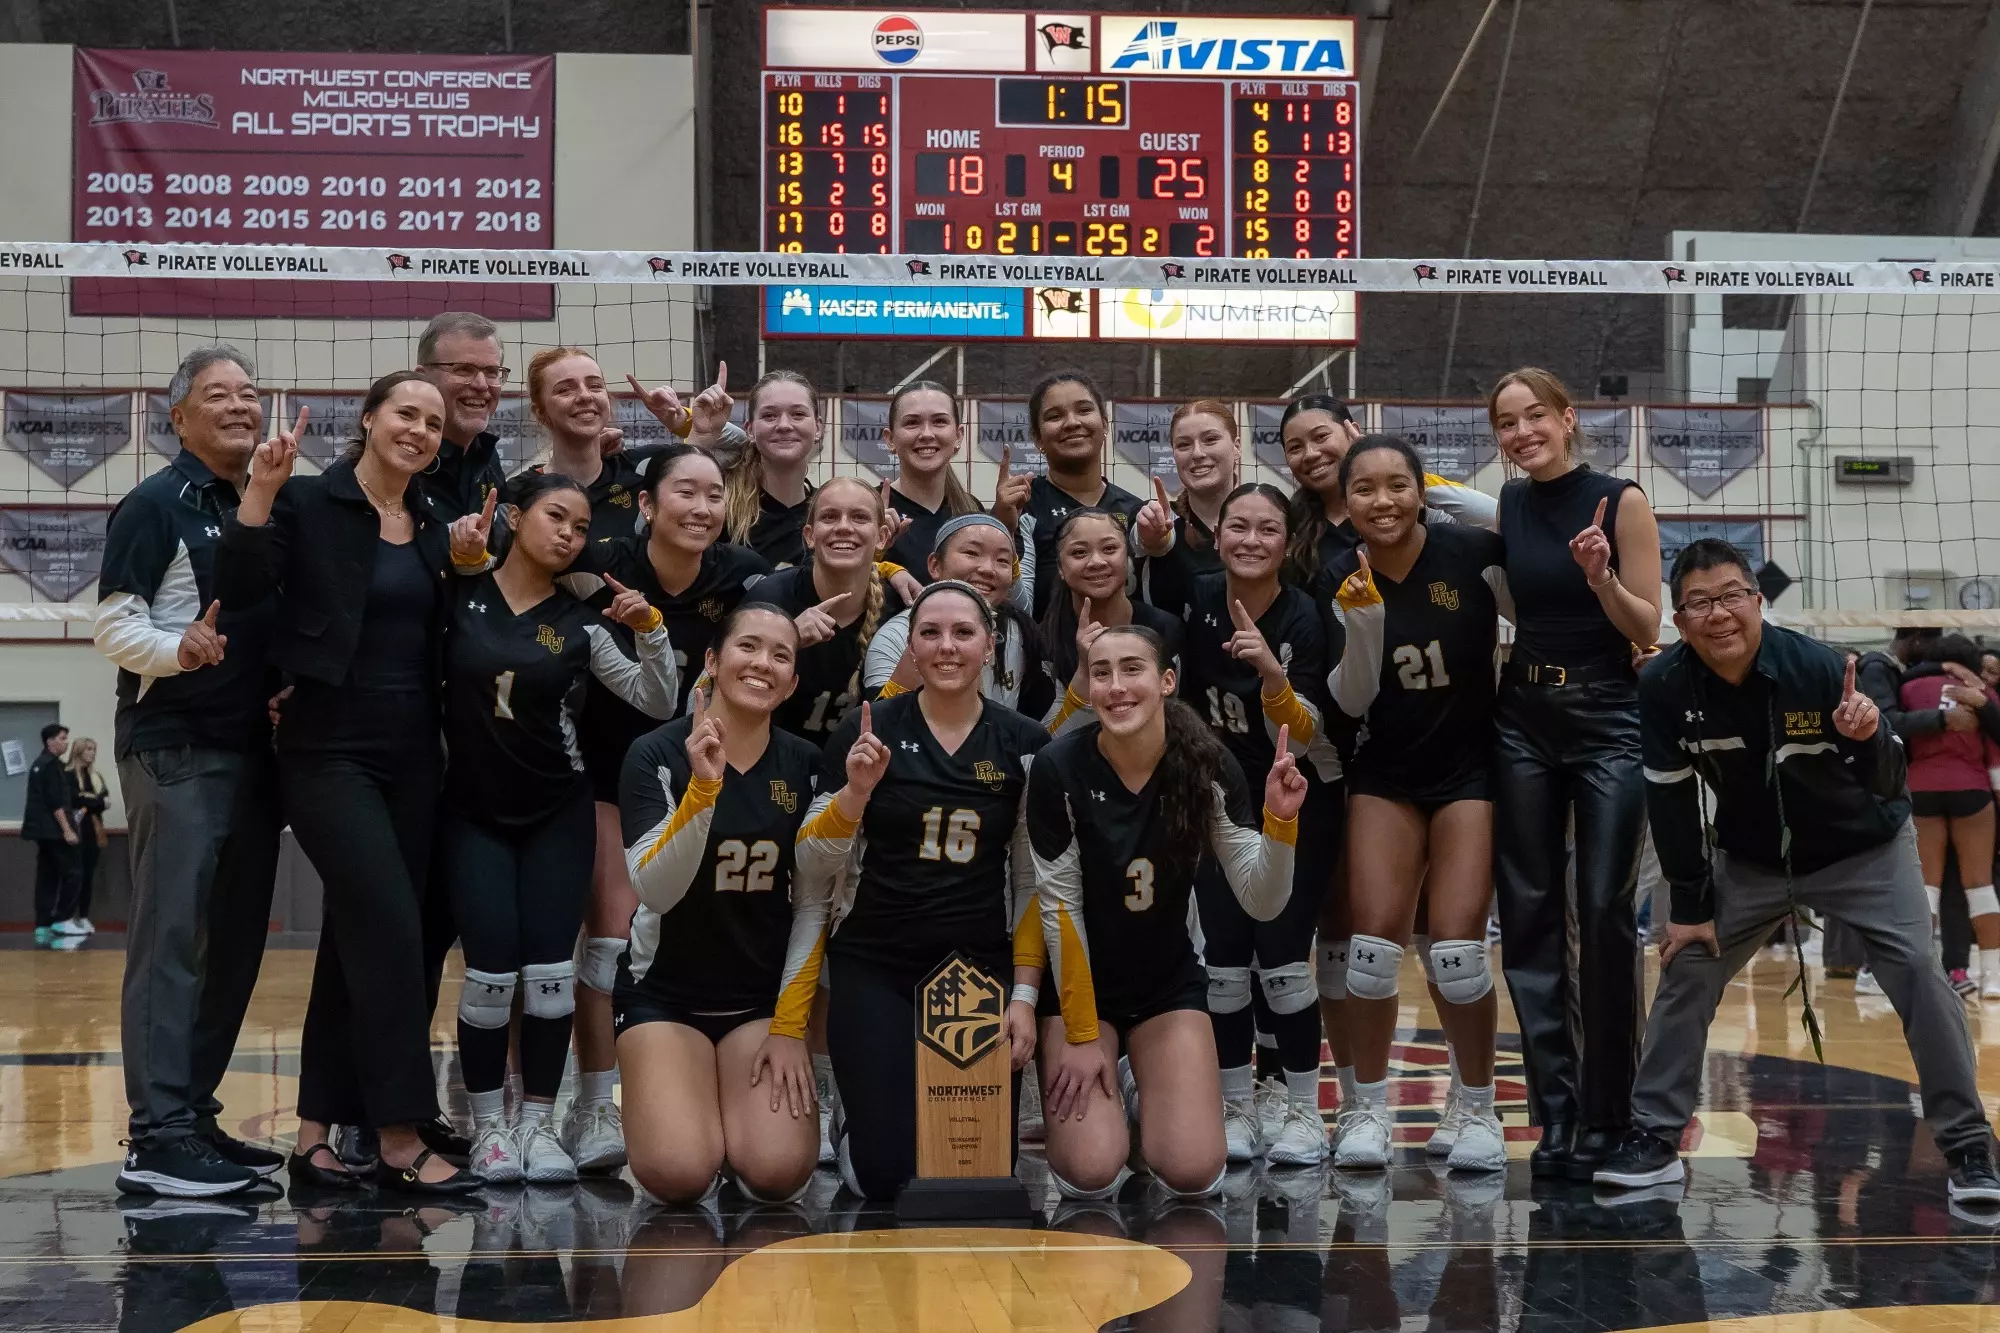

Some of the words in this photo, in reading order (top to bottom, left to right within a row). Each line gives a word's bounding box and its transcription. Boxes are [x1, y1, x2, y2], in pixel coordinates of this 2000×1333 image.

[876, 35, 920, 46] PEPSI
[1110, 21, 1346, 71] AVISTA
[241, 68, 379, 87] NORTHWEST
[384, 71, 532, 89] CONFERENCE
[774, 75, 801, 88] PLYR
[814, 75, 842, 89] KILLS
[857, 76, 882, 89] DIGS
[1240, 82, 1266, 95] PLYR
[1281, 83, 1309, 96] KILLS
[1323, 84, 1346, 97] DIGS
[89, 89, 215, 122] PIRATES
[303, 90, 470, 109] MCILROY-LEWIS
[779, 92, 803, 116] 10
[1048, 84, 1122, 123] 1:15
[1253, 102, 1269, 122] 4
[1286, 102, 1310, 122] 11
[1335, 101, 1351, 125] 8
[232, 112, 284, 136] ALL
[291, 112, 411, 137] SPORTS
[418, 115, 540, 139] TROPHY
[779, 121, 803, 146] 16
[821, 123, 845, 147] 15
[863, 123, 887, 147] 15
[926, 129, 980, 148] HOME
[1139, 132, 1201, 152] GUEST
[1253, 130, 1269, 153] 6
[1327, 131, 1351, 154] 13
[779, 151, 803, 176] 13
[832, 153, 845, 174] 7
[871, 153, 887, 176] 0
[1039, 145, 1085, 158] PERIOD
[949, 155, 984, 195] 18
[1053, 162, 1073, 191] 4
[1153, 159, 1205, 198] 25
[1253, 159, 1269, 183] 8
[1296, 160, 1310, 183] 2
[86, 173, 154, 194] 2005
[165, 174, 232, 195] 2008
[243, 175, 310, 196] 2009
[321, 176, 387, 197] 2010
[398, 177, 462, 198] 2011
[475, 178, 541, 199] 2012
[779, 181, 803, 206] 15
[830, 183, 845, 206] 2
[871, 183, 887, 206] 5
[916, 203, 945, 216] WON
[995, 203, 1018, 216] LST
[1021, 203, 1042, 217] GM
[1083, 204, 1107, 217] LST
[1109, 204, 1130, 218] GM
[1246, 188, 1270, 213] 12
[1295, 189, 1311, 213] 0
[1336, 190, 1351, 213] 0
[86, 206, 153, 227] 2013
[165, 207, 232, 228] 2014
[243, 208, 309, 229] 2015
[320, 209, 387, 230] 2016
[398, 210, 464, 231] 2017
[475, 211, 541, 232] 2018
[779, 211, 803, 234] 17
[829, 212, 845, 236] 0
[871, 212, 887, 236] 8
[1179, 207, 1209, 220] WON
[966, 225, 982, 249] 0
[997, 222, 1040, 254] 21
[1085, 223, 1129, 255] 25
[1143, 228, 1158, 252] 2
[1195, 225, 1215, 256] 2
[1246, 217, 1270, 242] 15
[1295, 219, 1311, 242] 8
[1336, 219, 1352, 243] 2
[1, 253, 64, 268] EYBALL
[158, 255, 216, 270] PIRATE
[222, 256, 328, 272] VOLLEYBALL
[421, 259, 479, 274] PIRATE
[486, 260, 590, 277] VOLLEYBALL
[682, 262, 740, 277] PIRATE
[746, 262, 849, 278] VOLLEYBALL
[940, 265, 997, 279] PIRATE
[1002, 266, 1105, 282] VOLLEYBALL
[1194, 268, 1250, 283] PIRATE
[1256, 269, 1357, 284] VOLLEYBALL
[1446, 269, 1502, 284] PIRATE
[1507, 270, 1608, 286] VOLLEYBALL
[1695, 272, 1750, 287] PIRATE
[1754, 272, 1854, 287] VOLLEYBALL
[1940, 272, 1994, 287] PIRATE
[819, 299, 878, 318] KAISER
[1188, 304, 1327, 323] NUMERICA
[8, 420, 53, 434] NCAA
[982, 428, 1025, 442] NAIA
[1117, 430, 1160, 443] NCAA
[1252, 431, 1282, 445] NCA
[1651, 435, 1690, 448] NCAA
[1428, 581, 1460, 611] PLU
[536, 624, 564, 654] PLU
[1392, 639, 1451, 690] 21
[495, 670, 515, 720] 1
[1205, 685, 1249, 734] 19
[1784, 711, 1821, 728] PLU
[1786, 728, 1823, 736] VOLLEYBALL
[974, 760, 1005, 792] PLU
[770, 780, 798, 814] PLU
[919, 806, 981, 864] 16
[715, 839, 780, 893] 22
[1124, 857, 1155, 912] 3
[927, 1085, 1002, 1096] NORTHWEST
